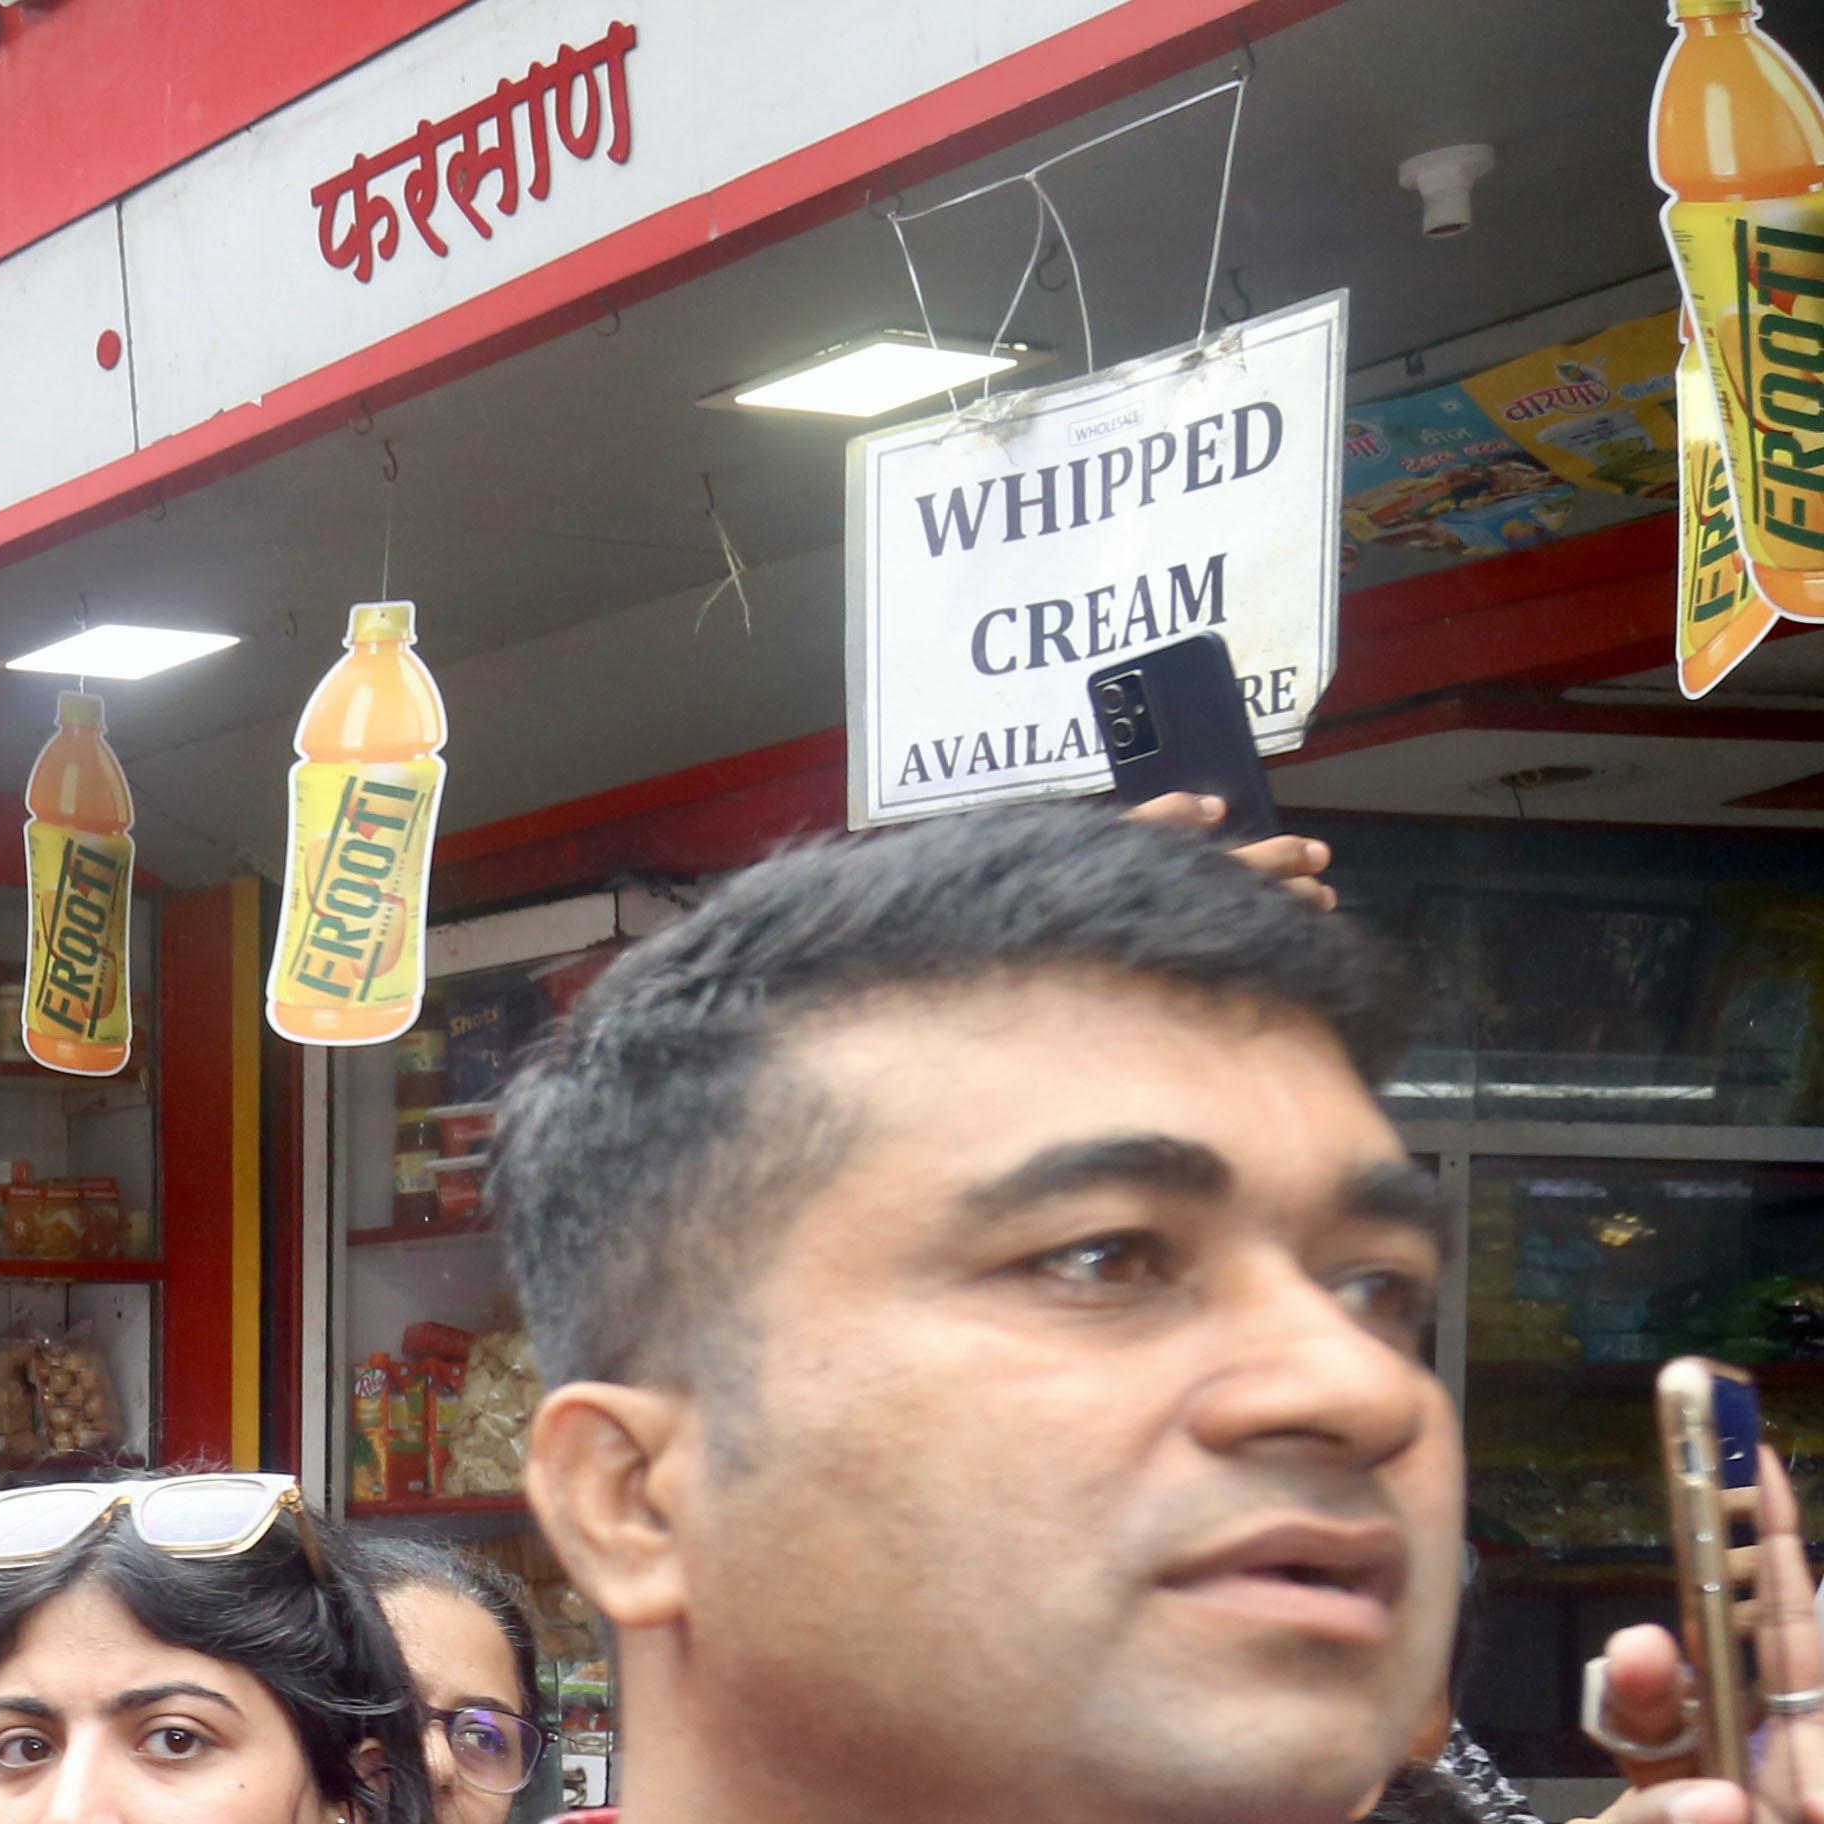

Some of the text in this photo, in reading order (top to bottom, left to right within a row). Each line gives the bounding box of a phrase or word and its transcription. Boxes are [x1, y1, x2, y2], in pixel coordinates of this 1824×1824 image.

[309, 20, 638, 284] फरसाण
[915, 402, 1284, 558] WHIPPED
[971, 553, 1228, 676] CREAM
[898, 667, 1298, 786] AVAILA RE
[40, 844, 119, 1035] FROOTI
[296, 779, 419, 999] FROOTI
